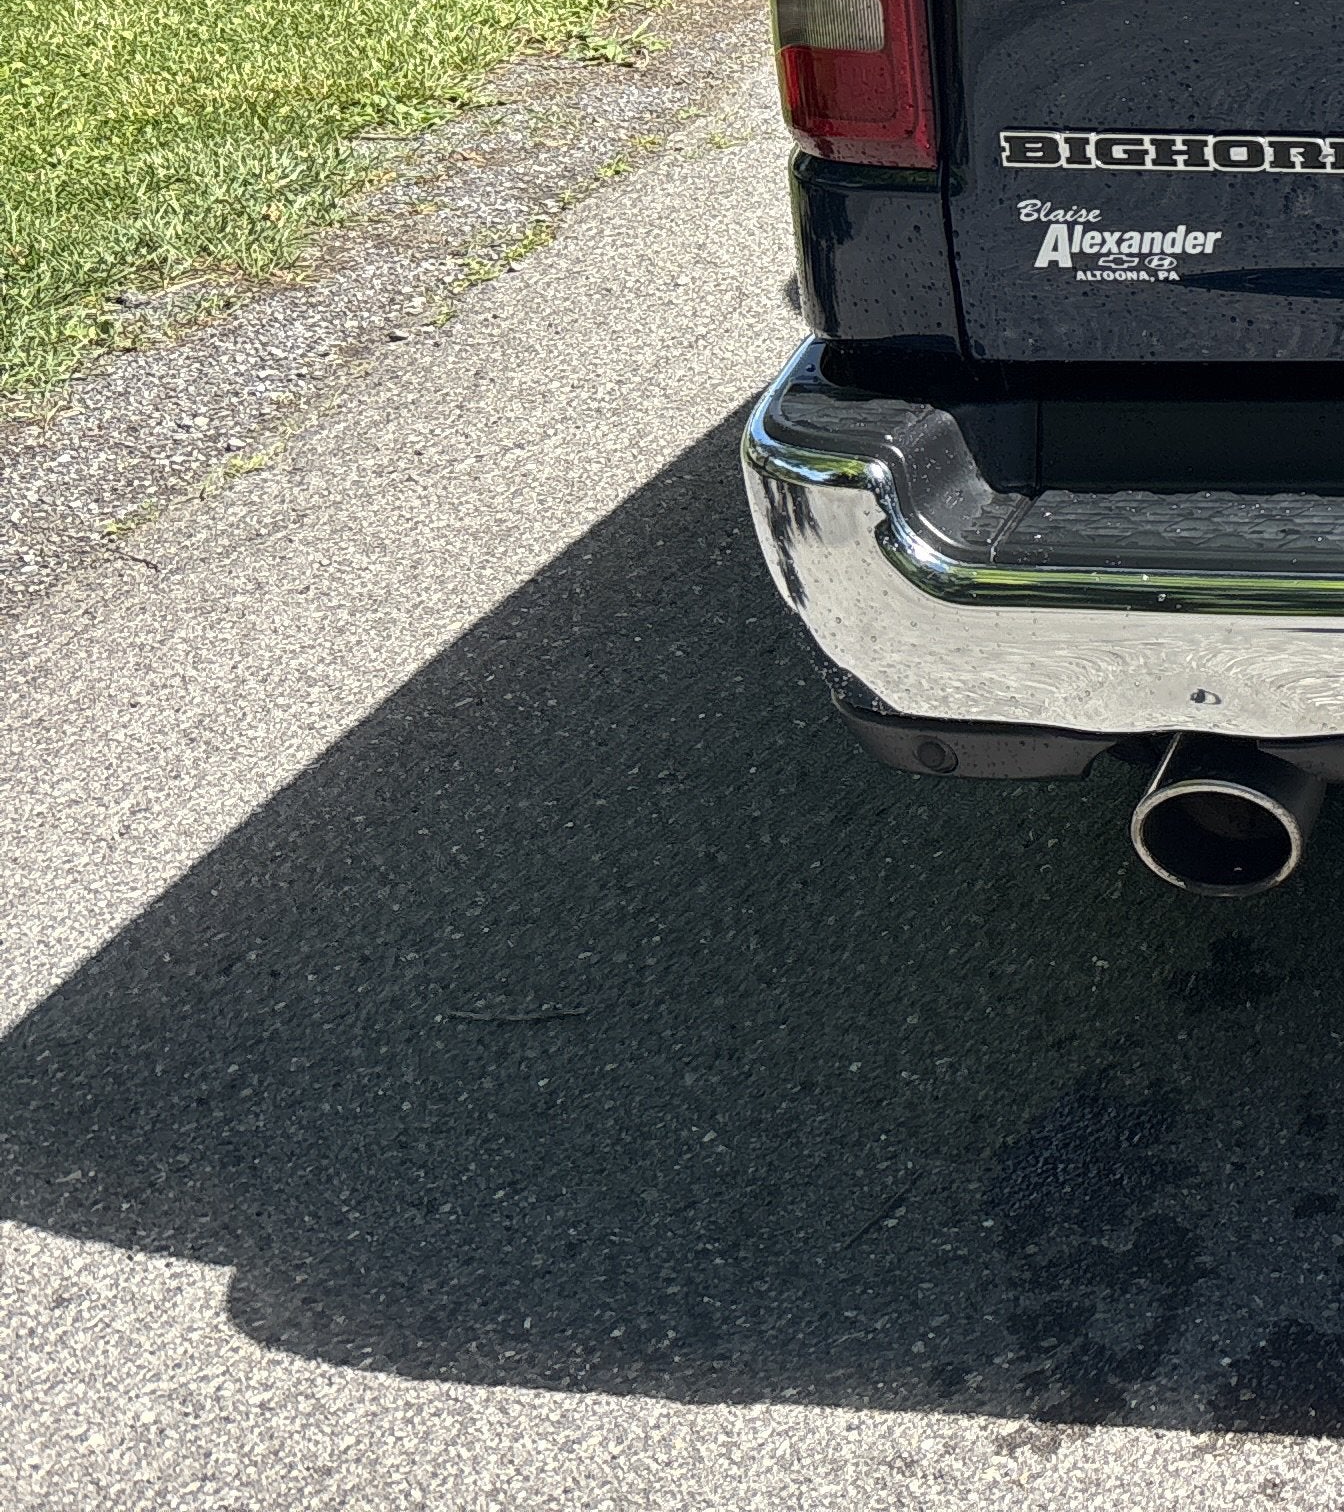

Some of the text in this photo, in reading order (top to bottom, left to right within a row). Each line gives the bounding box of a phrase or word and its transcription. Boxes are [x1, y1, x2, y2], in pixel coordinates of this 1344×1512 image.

[1017, 199, 1102, 223] Blaise
[1034, 223, 1223, 268] Alexander
[1076, 270, 1181, 282] ALTOONA, PA
